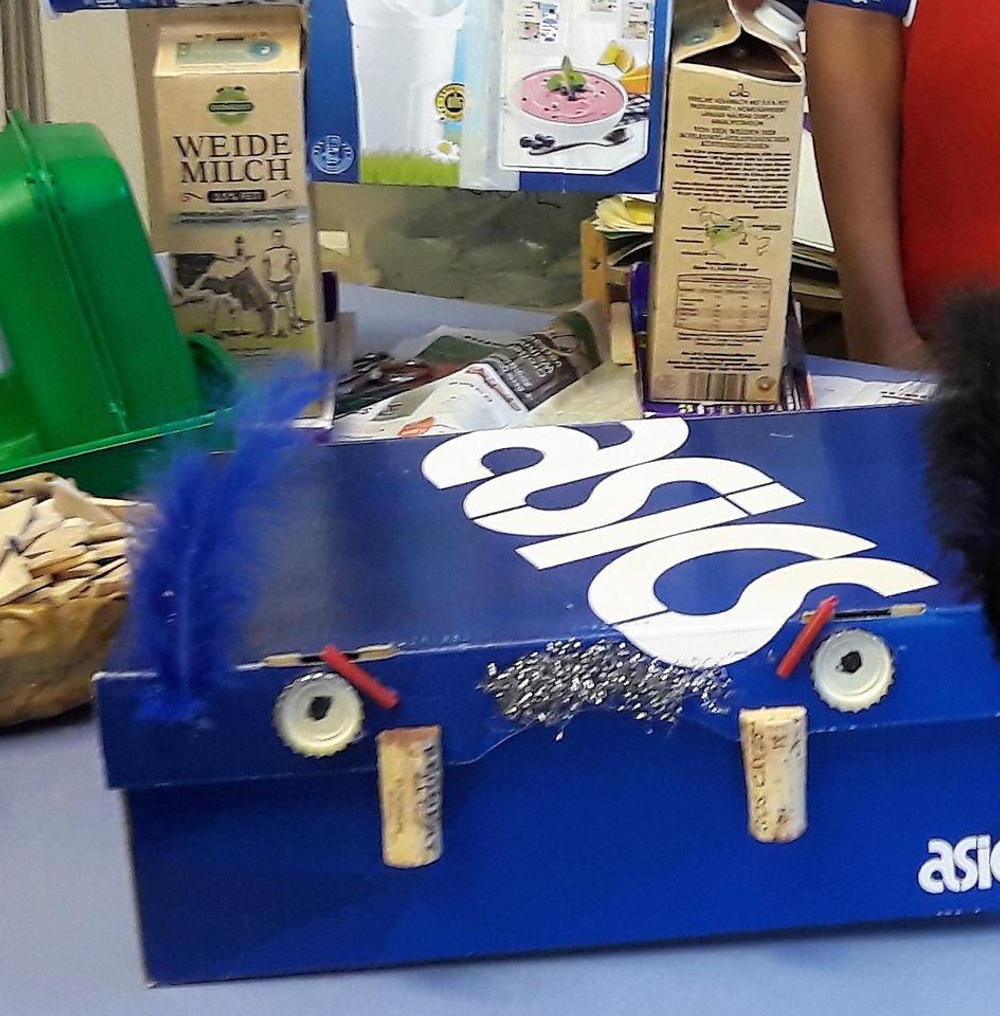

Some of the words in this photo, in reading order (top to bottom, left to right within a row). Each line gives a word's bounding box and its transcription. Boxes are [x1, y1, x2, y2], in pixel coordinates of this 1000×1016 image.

[173, 134, 293, 158] WEIDE
[181, 158, 292, 184] MILCH
[421, 417, 940, 669] asics
